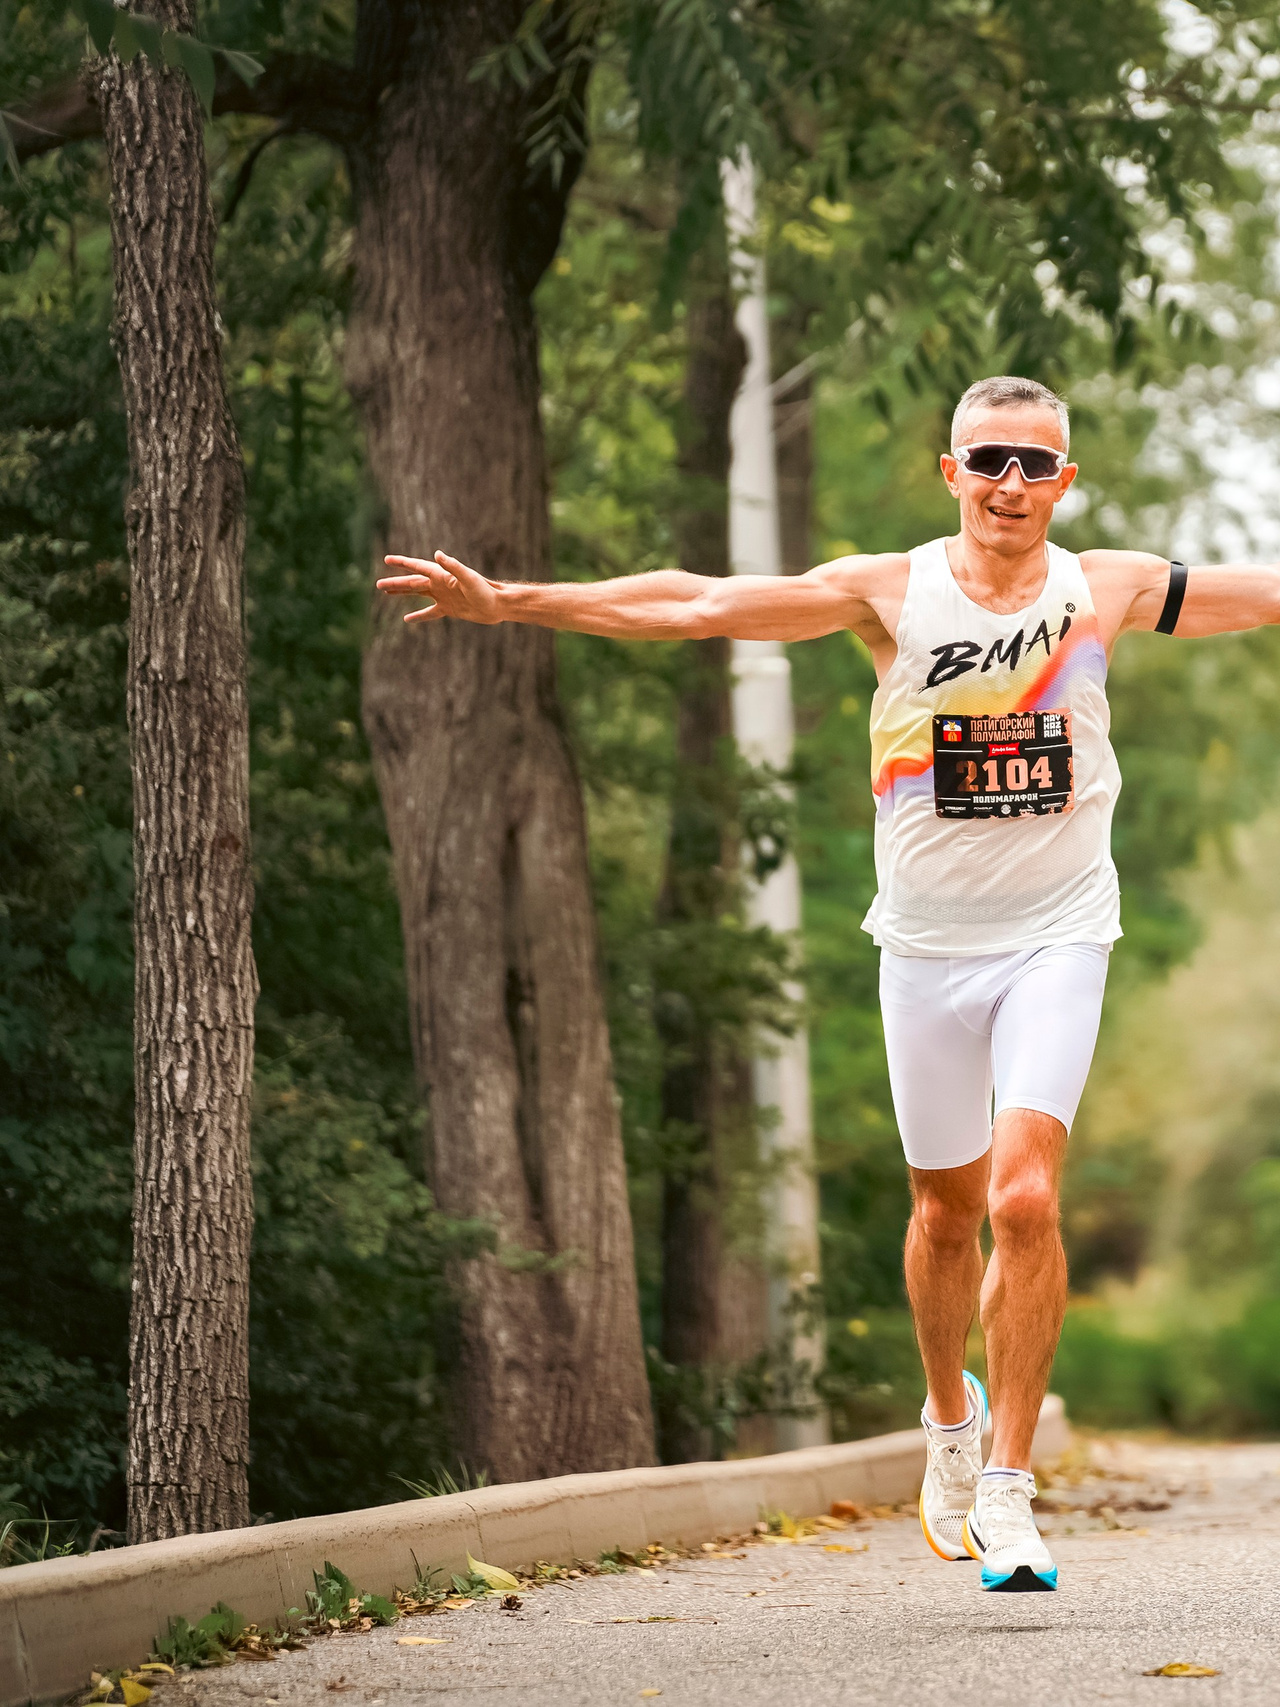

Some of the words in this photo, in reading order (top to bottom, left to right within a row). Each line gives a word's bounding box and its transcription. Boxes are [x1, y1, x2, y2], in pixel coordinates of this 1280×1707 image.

[971, 715, 1035, 731] ПЯТИГОРСКИЙ
[971, 729, 1036, 742] ПОЛУМАРАФОН
[1044, 729, 1061, 738] RUN
[955, 755, 1053, 792] 2104
[973, 793, 1038, 803] ПОЛУМАРАФОН
